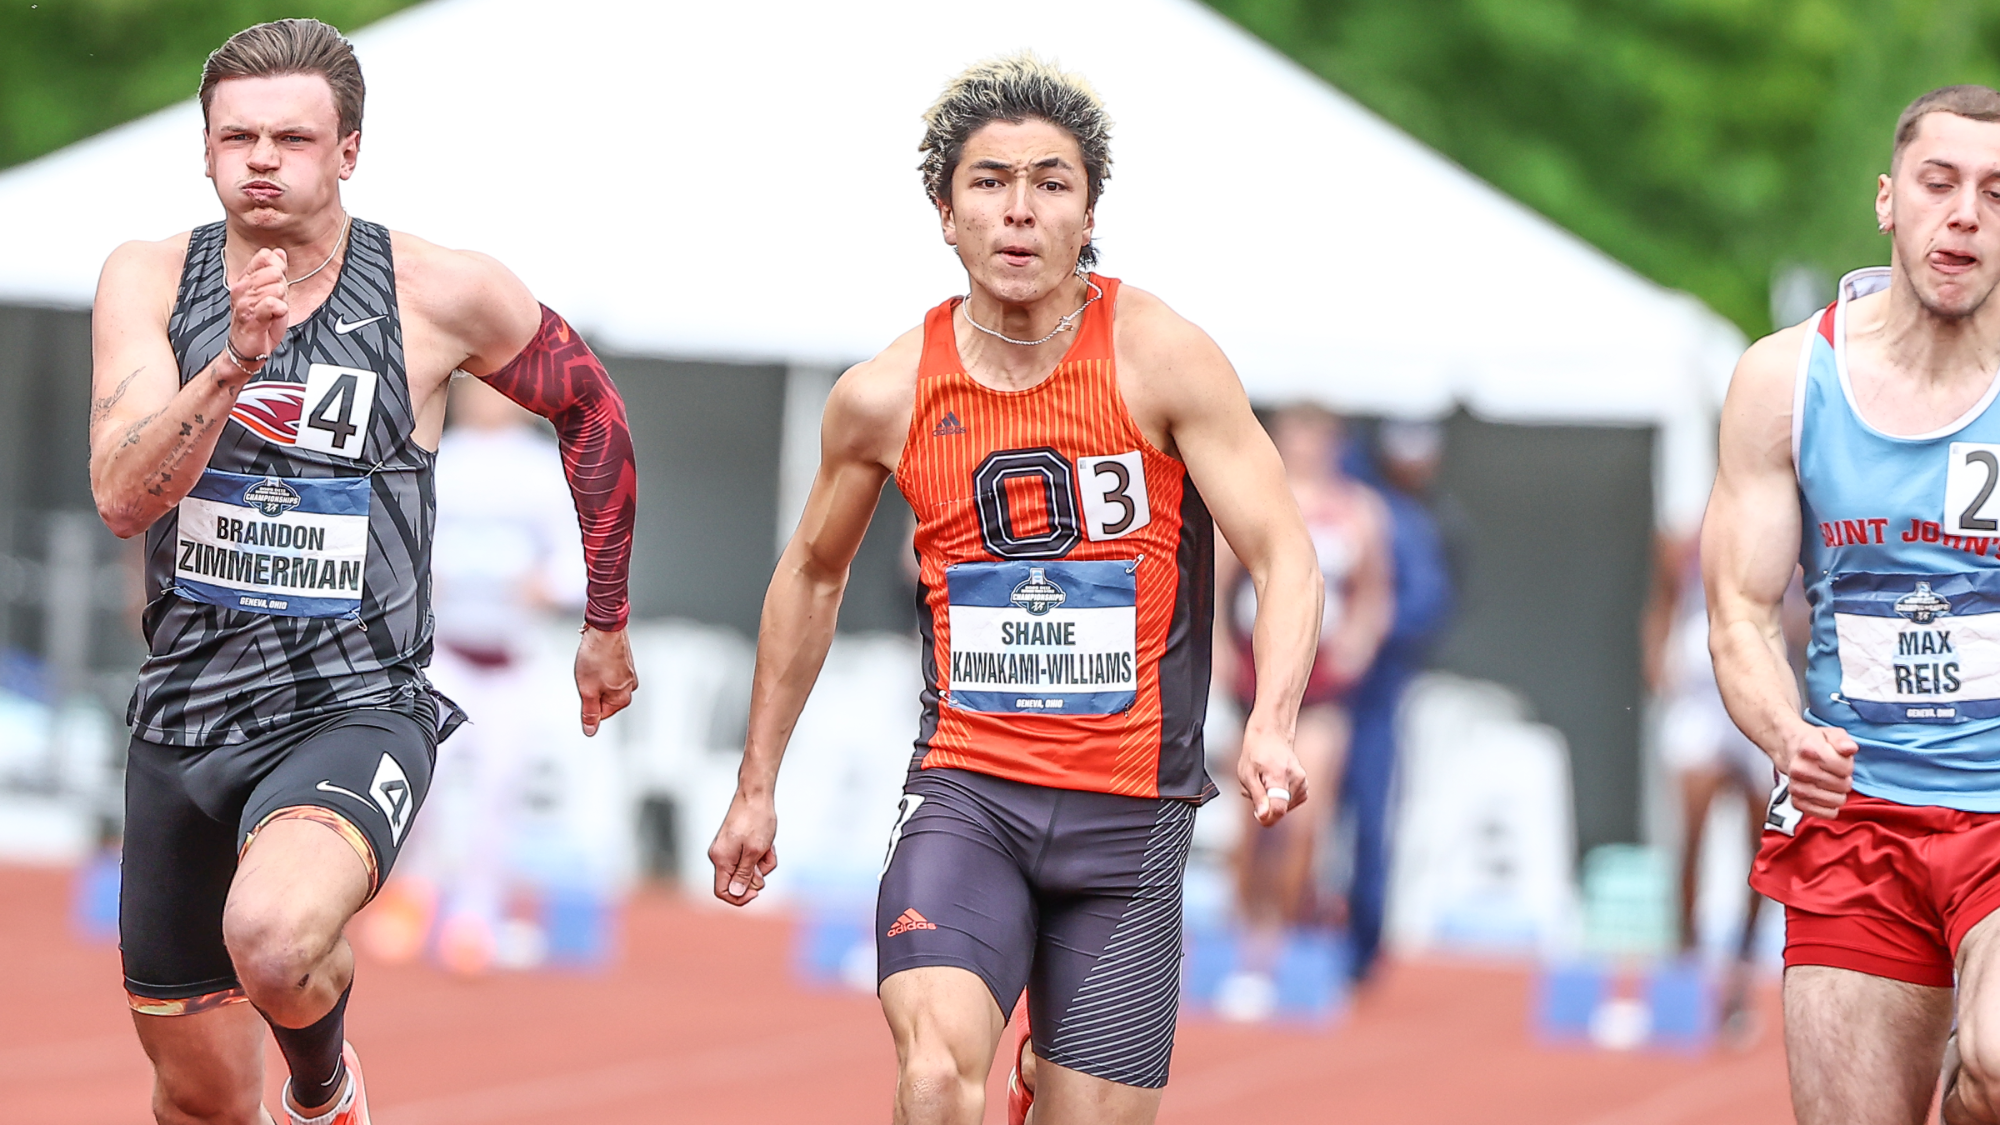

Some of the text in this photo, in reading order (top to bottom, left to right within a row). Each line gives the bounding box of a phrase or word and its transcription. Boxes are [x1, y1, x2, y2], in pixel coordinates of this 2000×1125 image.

[307, 374, 358, 449] 4
[932, 425, 966, 437] adidas
[245, 493, 299, 505] CHAMPIONSHIPS
[972, 446, 1082, 559] O
[1093, 461, 1135, 534] 3
[1959, 450, 1999, 531] 2
[216, 516, 325, 551] BRANDON
[179, 540, 361, 591] ZIMMERMAN
[239, 597, 288, 610] GENEVA, OHIO
[1012, 593, 1065, 602] CHAMPIONSHIPS
[1001, 621, 1076, 646] SHANE
[1898, 630, 1952, 655] MAX
[952, 651, 1132, 685] KAWAKAMI-WILLIAMS
[1894, 662, 1961, 694] REIS
[1016, 699, 1064, 709] GENEVA, OHIO
[379, 780, 408, 828] 4
[887, 921, 937, 938] adidas
